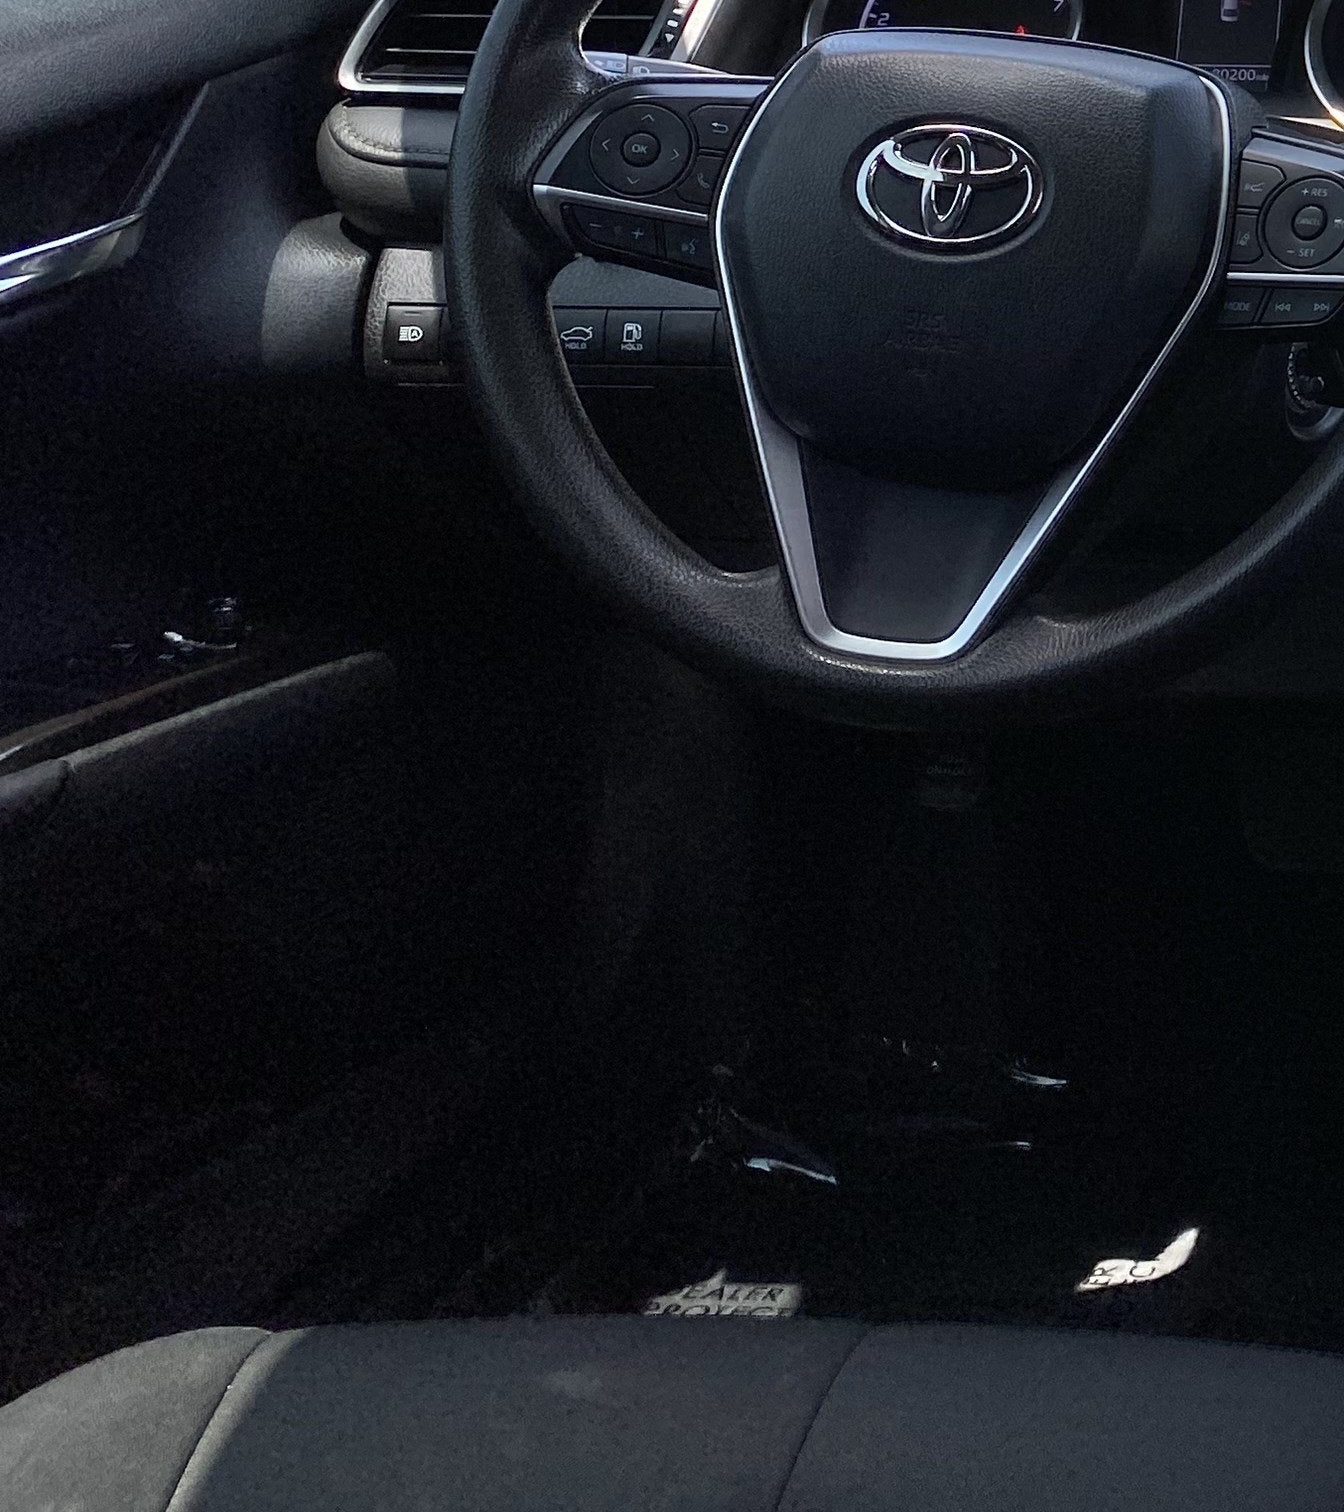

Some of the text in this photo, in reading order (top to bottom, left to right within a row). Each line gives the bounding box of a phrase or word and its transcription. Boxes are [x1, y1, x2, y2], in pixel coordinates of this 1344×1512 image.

[877, 12, 890, 26] 2
[631, 144, 648, 154] OK
[1311, 187, 1328, 197] RES
[1298, 248, 1316, 257] SET
[621, 343, 643, 351] HOLD
